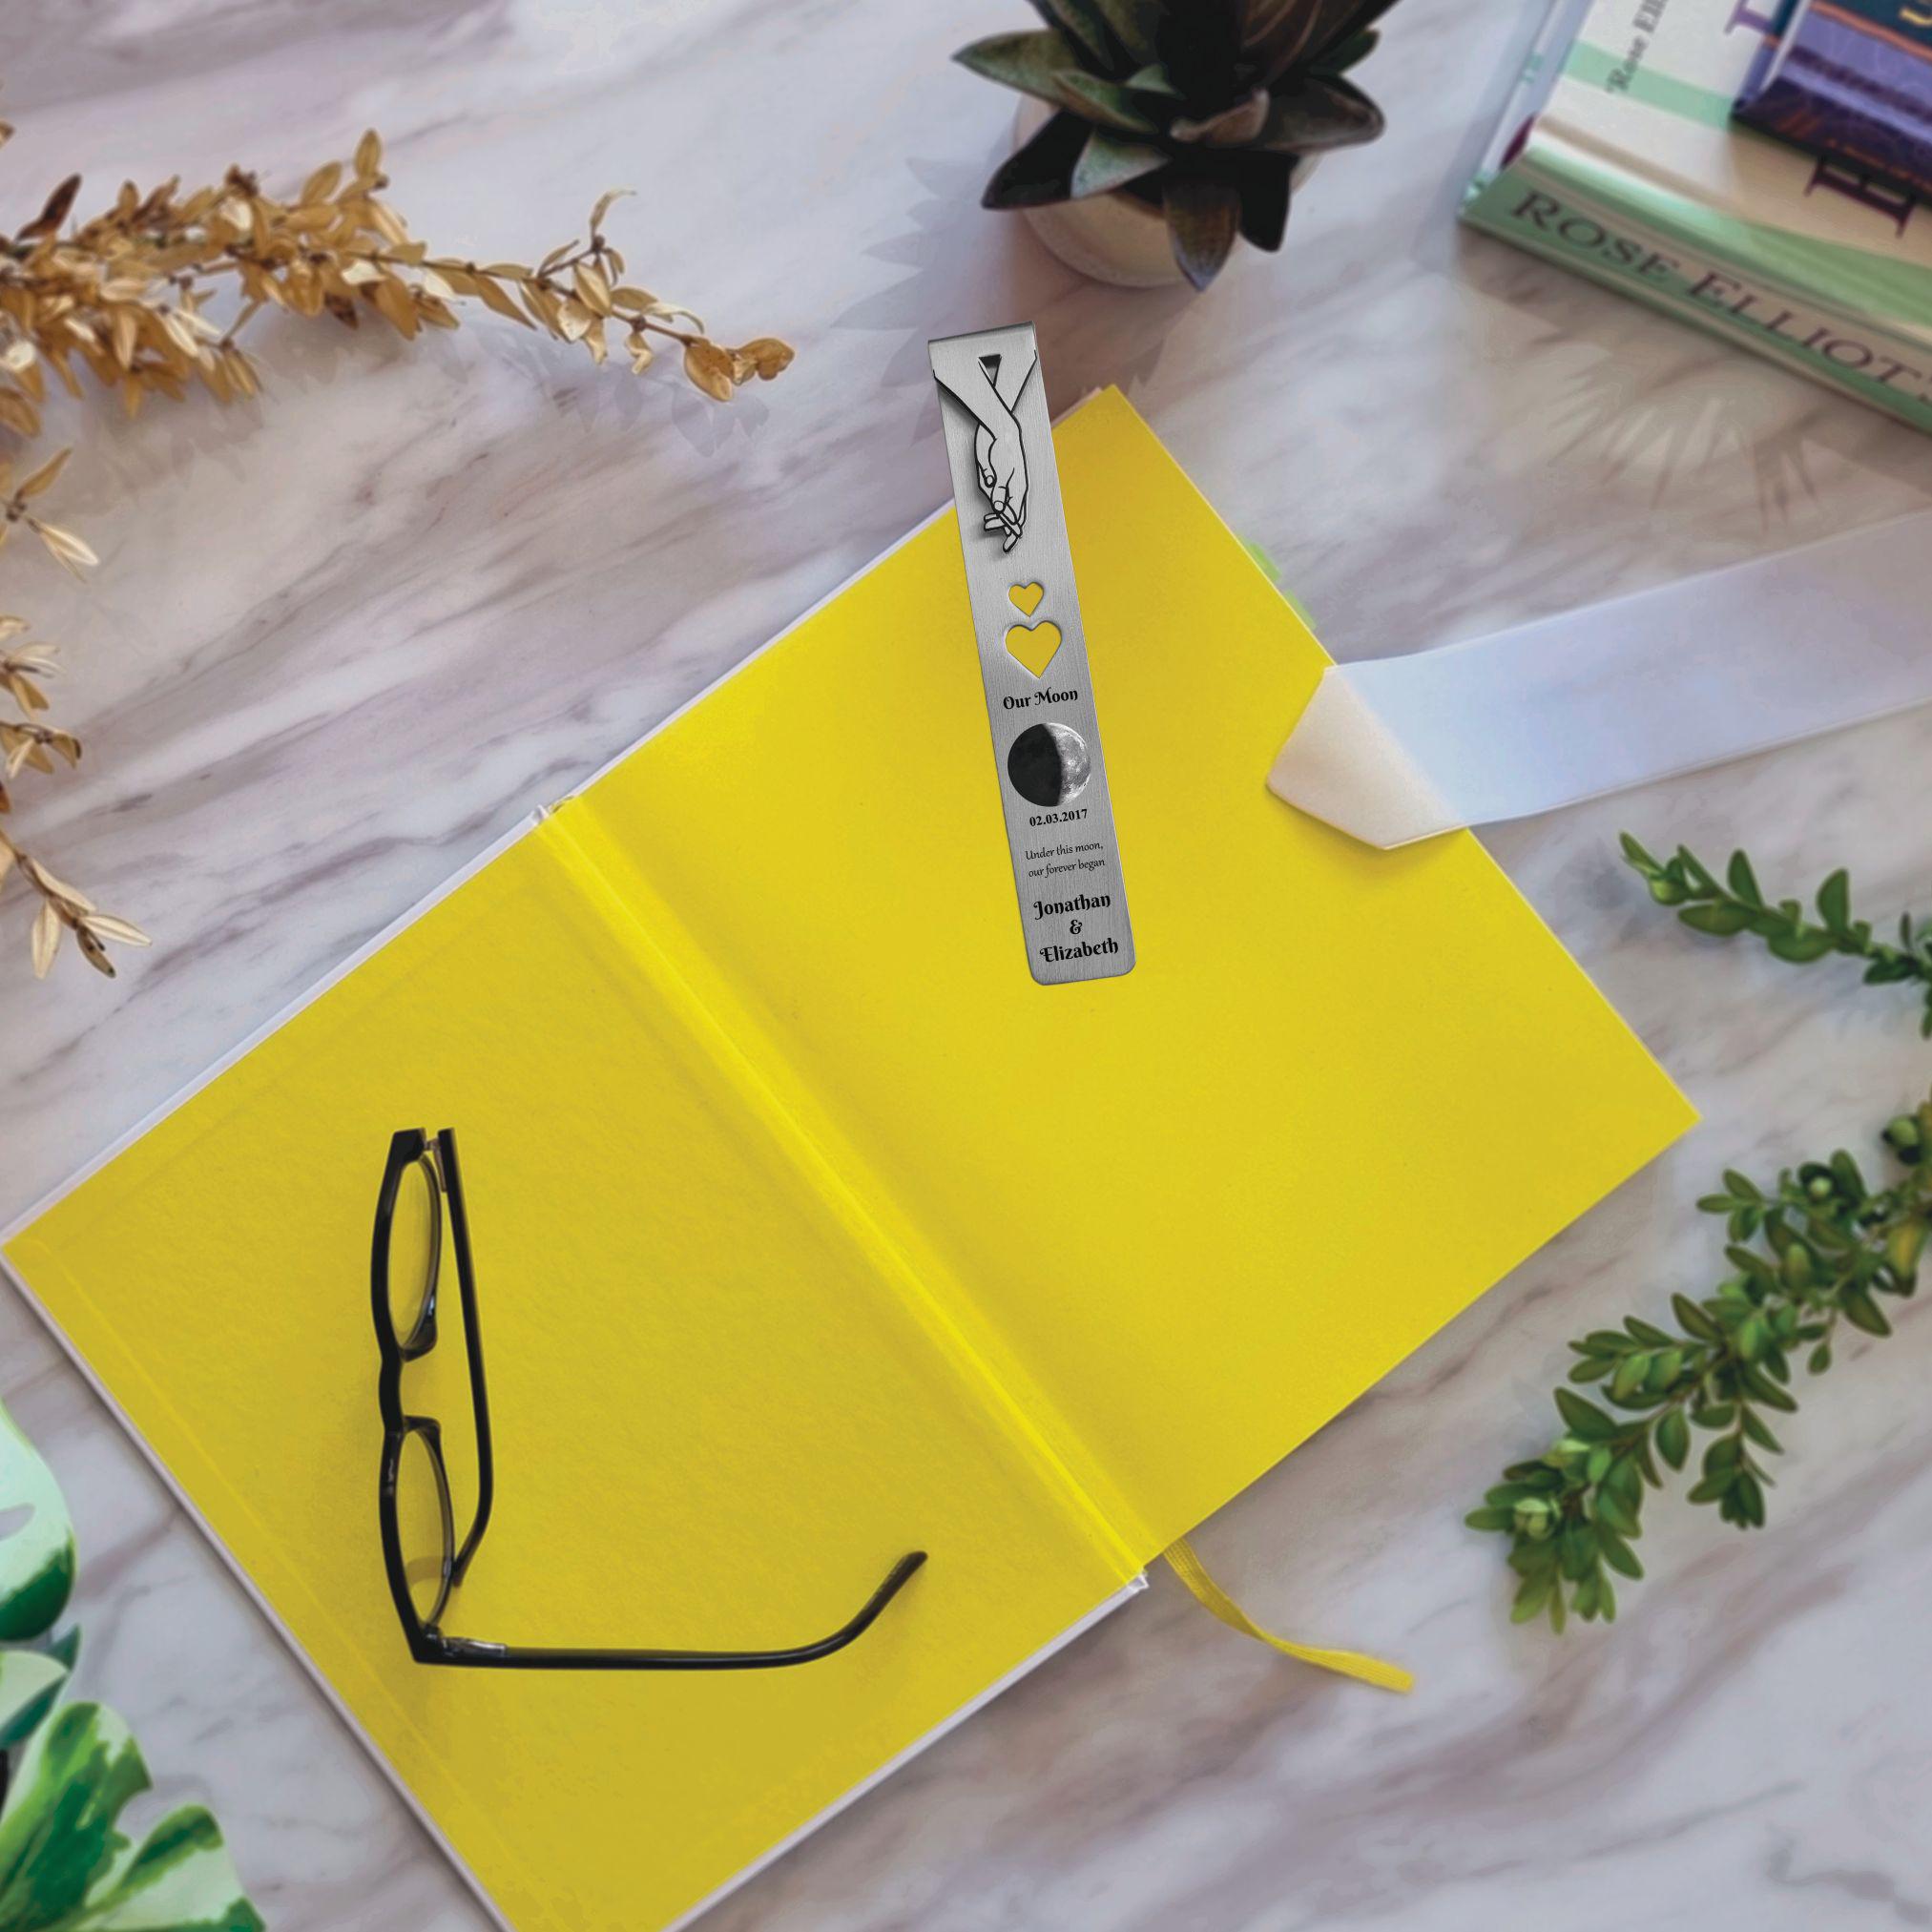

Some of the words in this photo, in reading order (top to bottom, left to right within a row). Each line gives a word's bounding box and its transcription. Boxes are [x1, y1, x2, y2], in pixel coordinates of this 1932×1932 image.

[1511, 190, 1680, 275] ROSE
[1688, 271, 1932, 403] ELLIOT
[1003, 696, 1031, 709] Our
[1034, 687, 1078, 705] Moon
[1029, 809, 1088, 827] 02.03.2017
[1025, 848, 1055, 860] Under
[1056, 844, 1073, 856] this
[1075, 841, 1104, 853] moon,
[1028, 868, 1045, 878] our
[1044, 862, 1077, 879] forever
[1078, 859, 1106, 872] began
[1033, 894, 1111, 921] Jonathan
[1070, 919, 1083, 935] &
[1039, 937, 1119, 963] Elizabeth
